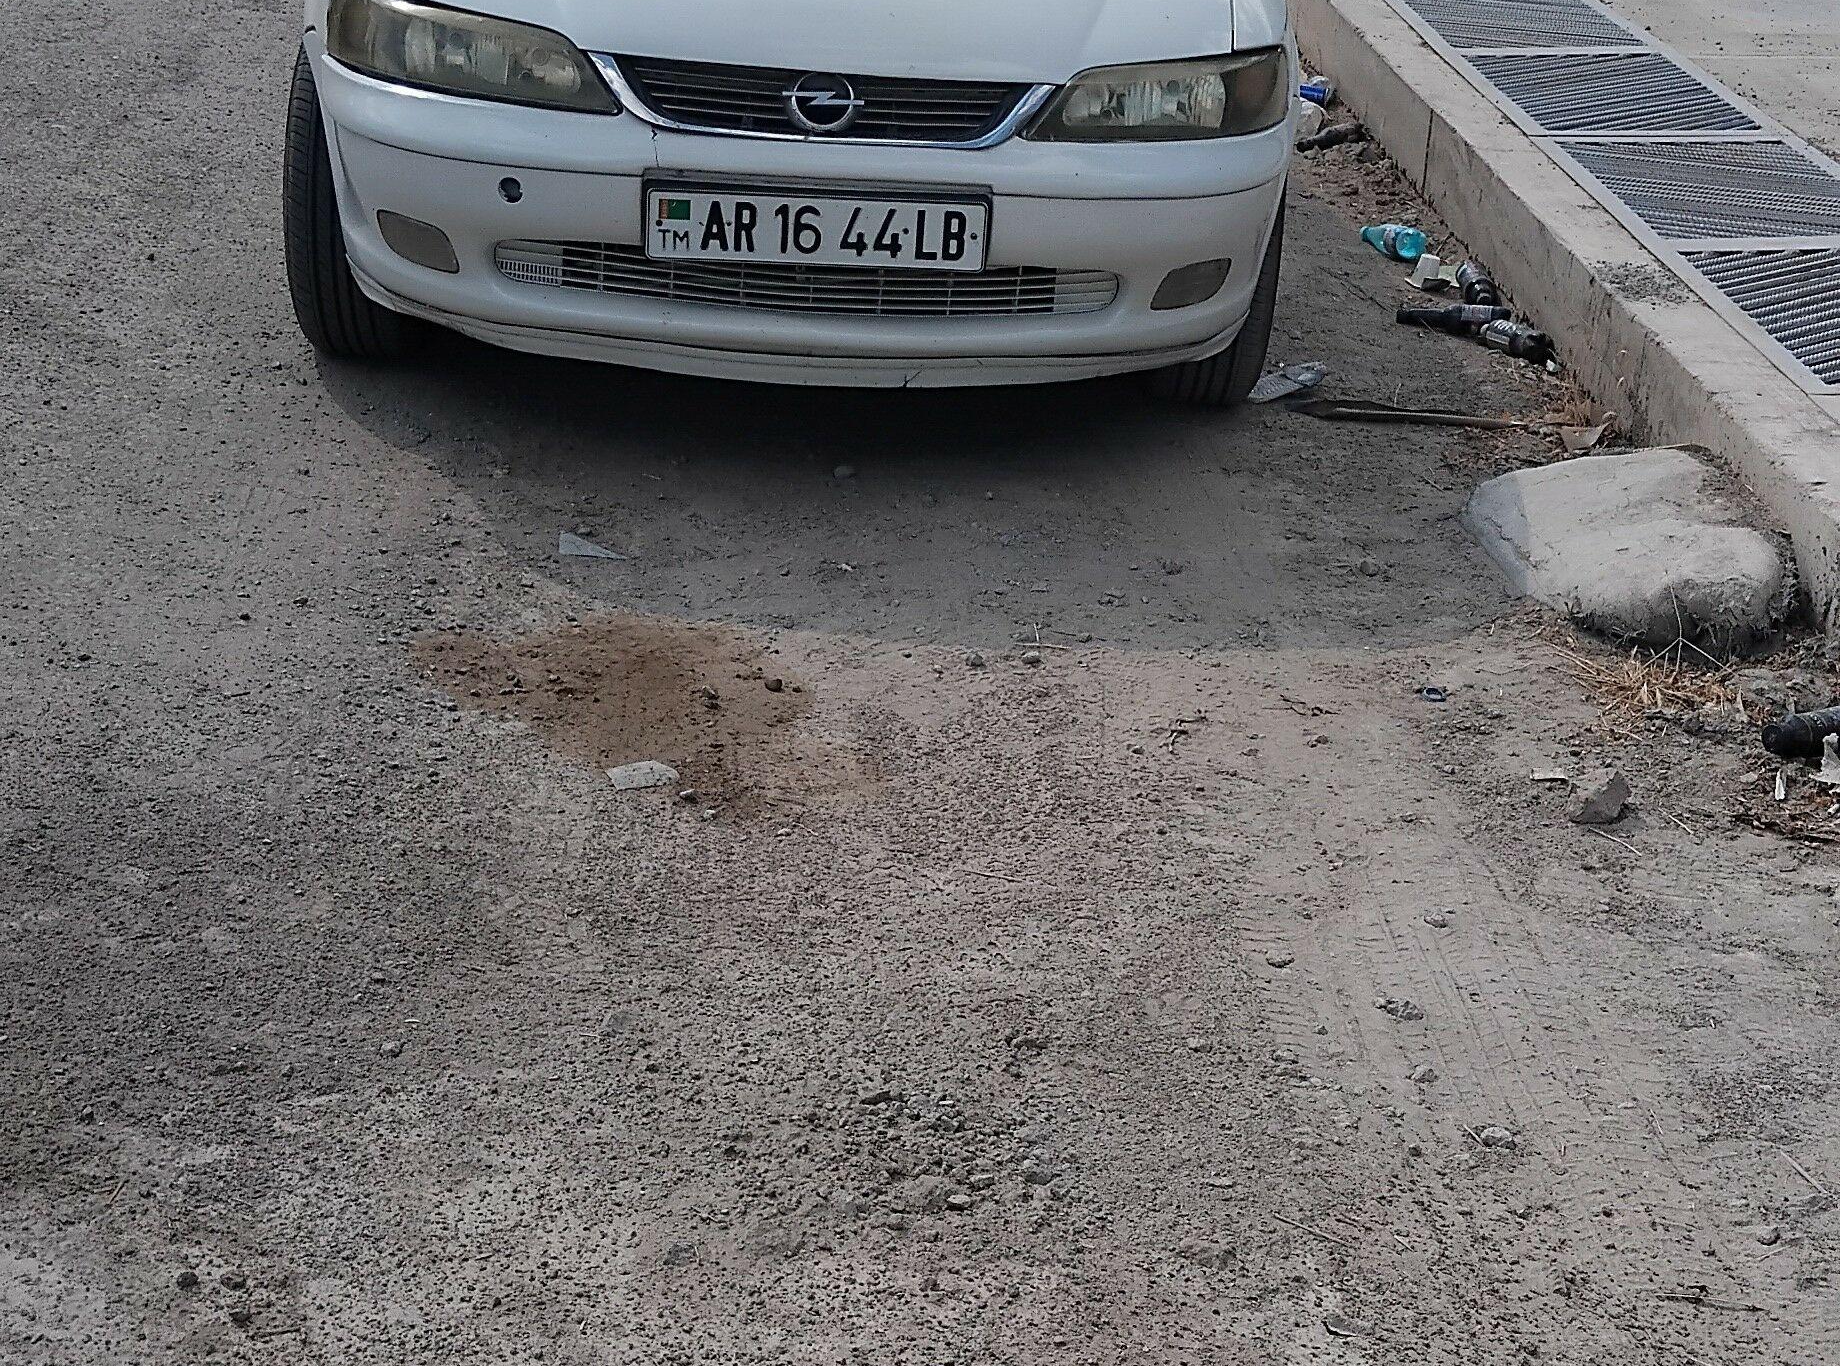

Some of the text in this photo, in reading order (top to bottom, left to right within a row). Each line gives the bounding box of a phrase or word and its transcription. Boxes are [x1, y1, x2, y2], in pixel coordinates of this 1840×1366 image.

[658, 227, 690, 251] TM
[700, 200, 966, 262] AR 16 44 LB
